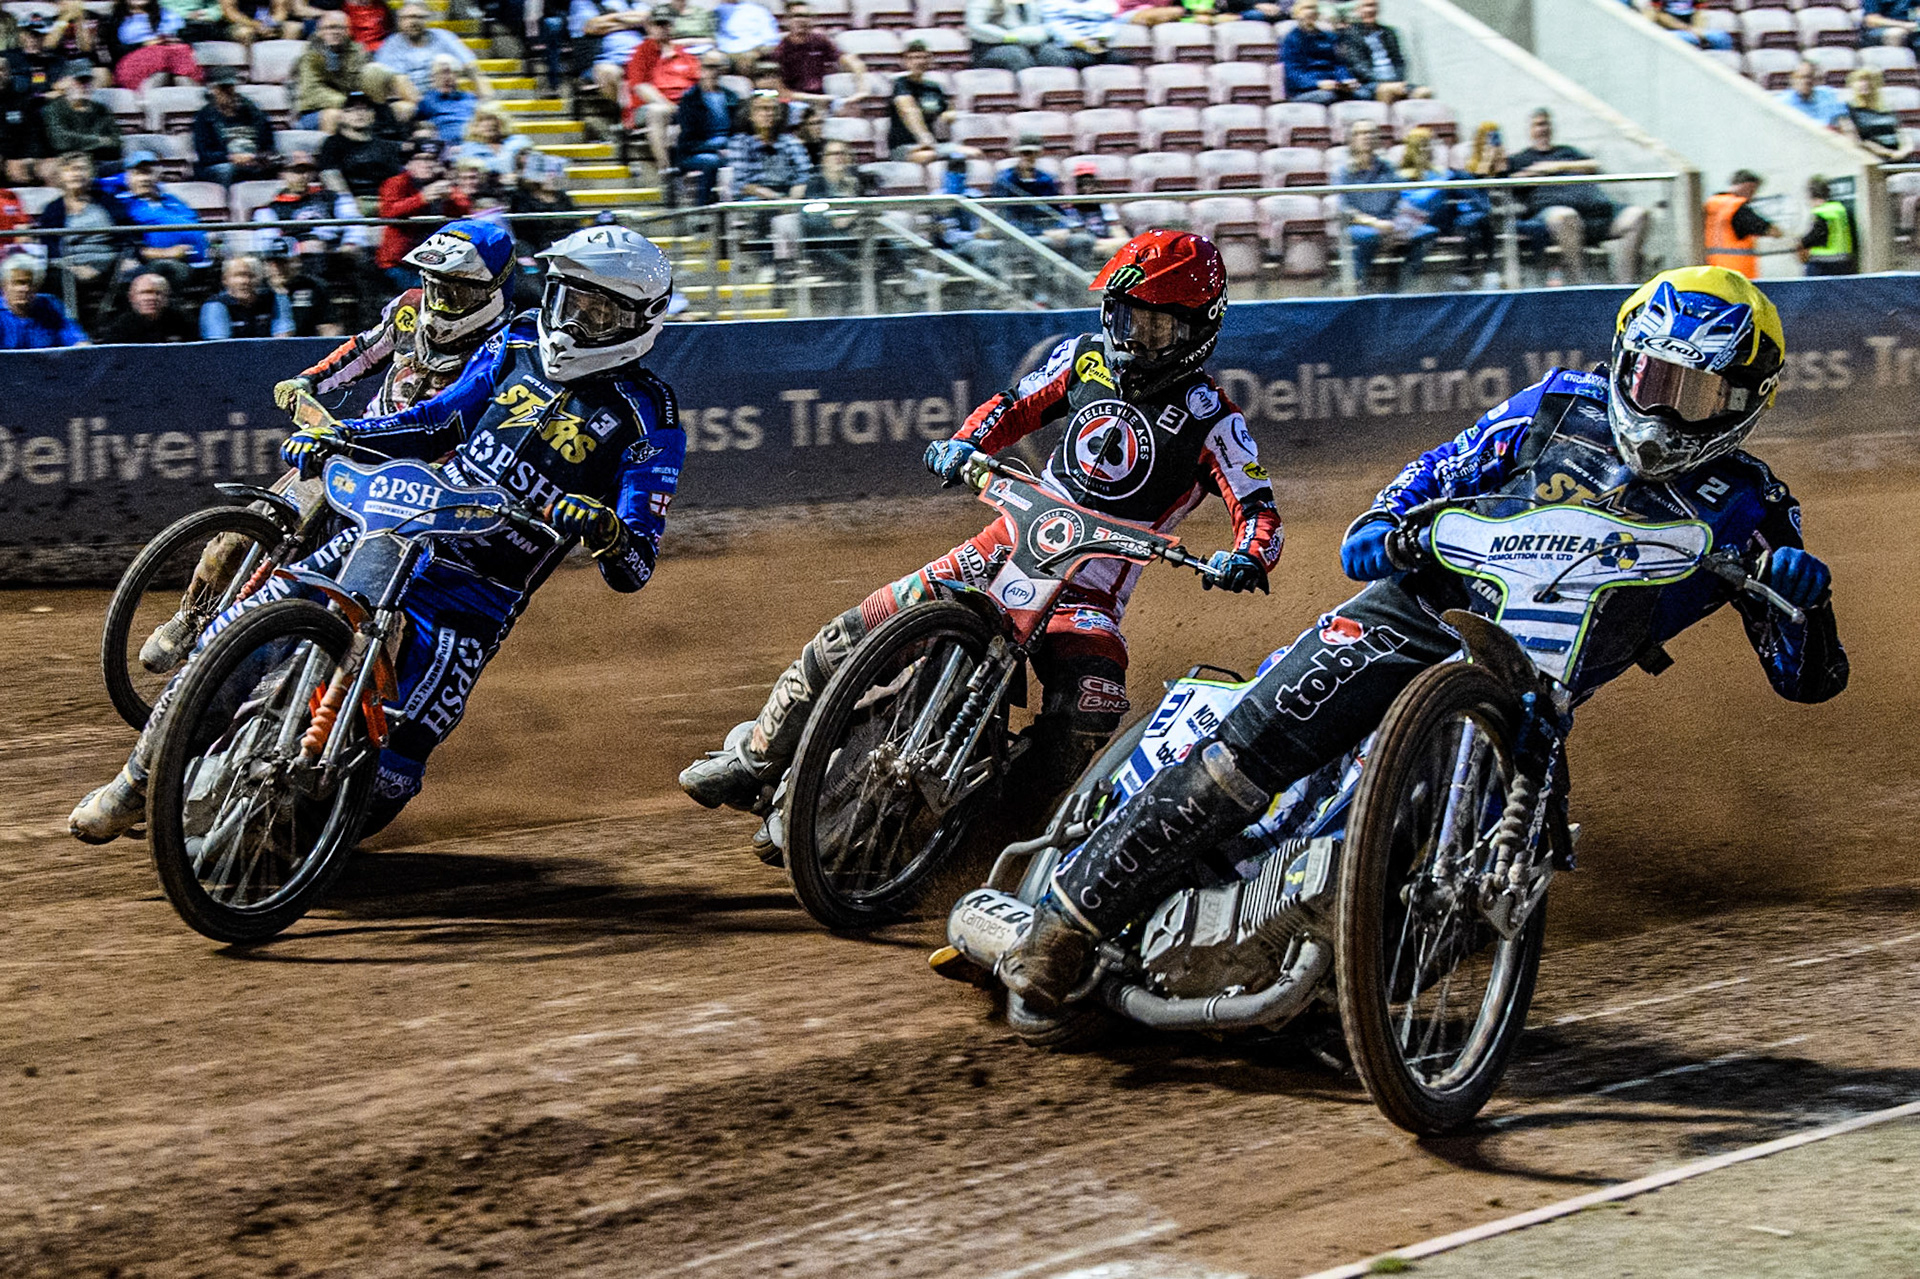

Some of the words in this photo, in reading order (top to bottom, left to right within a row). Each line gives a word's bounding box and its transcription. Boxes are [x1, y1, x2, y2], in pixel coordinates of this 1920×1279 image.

[780, 379, 970, 446] Travel
[1078, 405, 1112, 425] BELLE
[1135, 428, 1149, 460] ACES
[0, 411, 290, 485] eliverin
[487, 443, 563, 508] PSH
[387, 478, 443, 509] PSH
[1488, 552, 1538, 562] DEMOLITION
[1540, 552, 1554, 561] UK
[1557, 552, 1573, 562] LTD
[1007, 586, 1029, 600] ATPI
[421, 662, 473, 737] PSH
[1080, 797, 1206, 909] GLULAM
